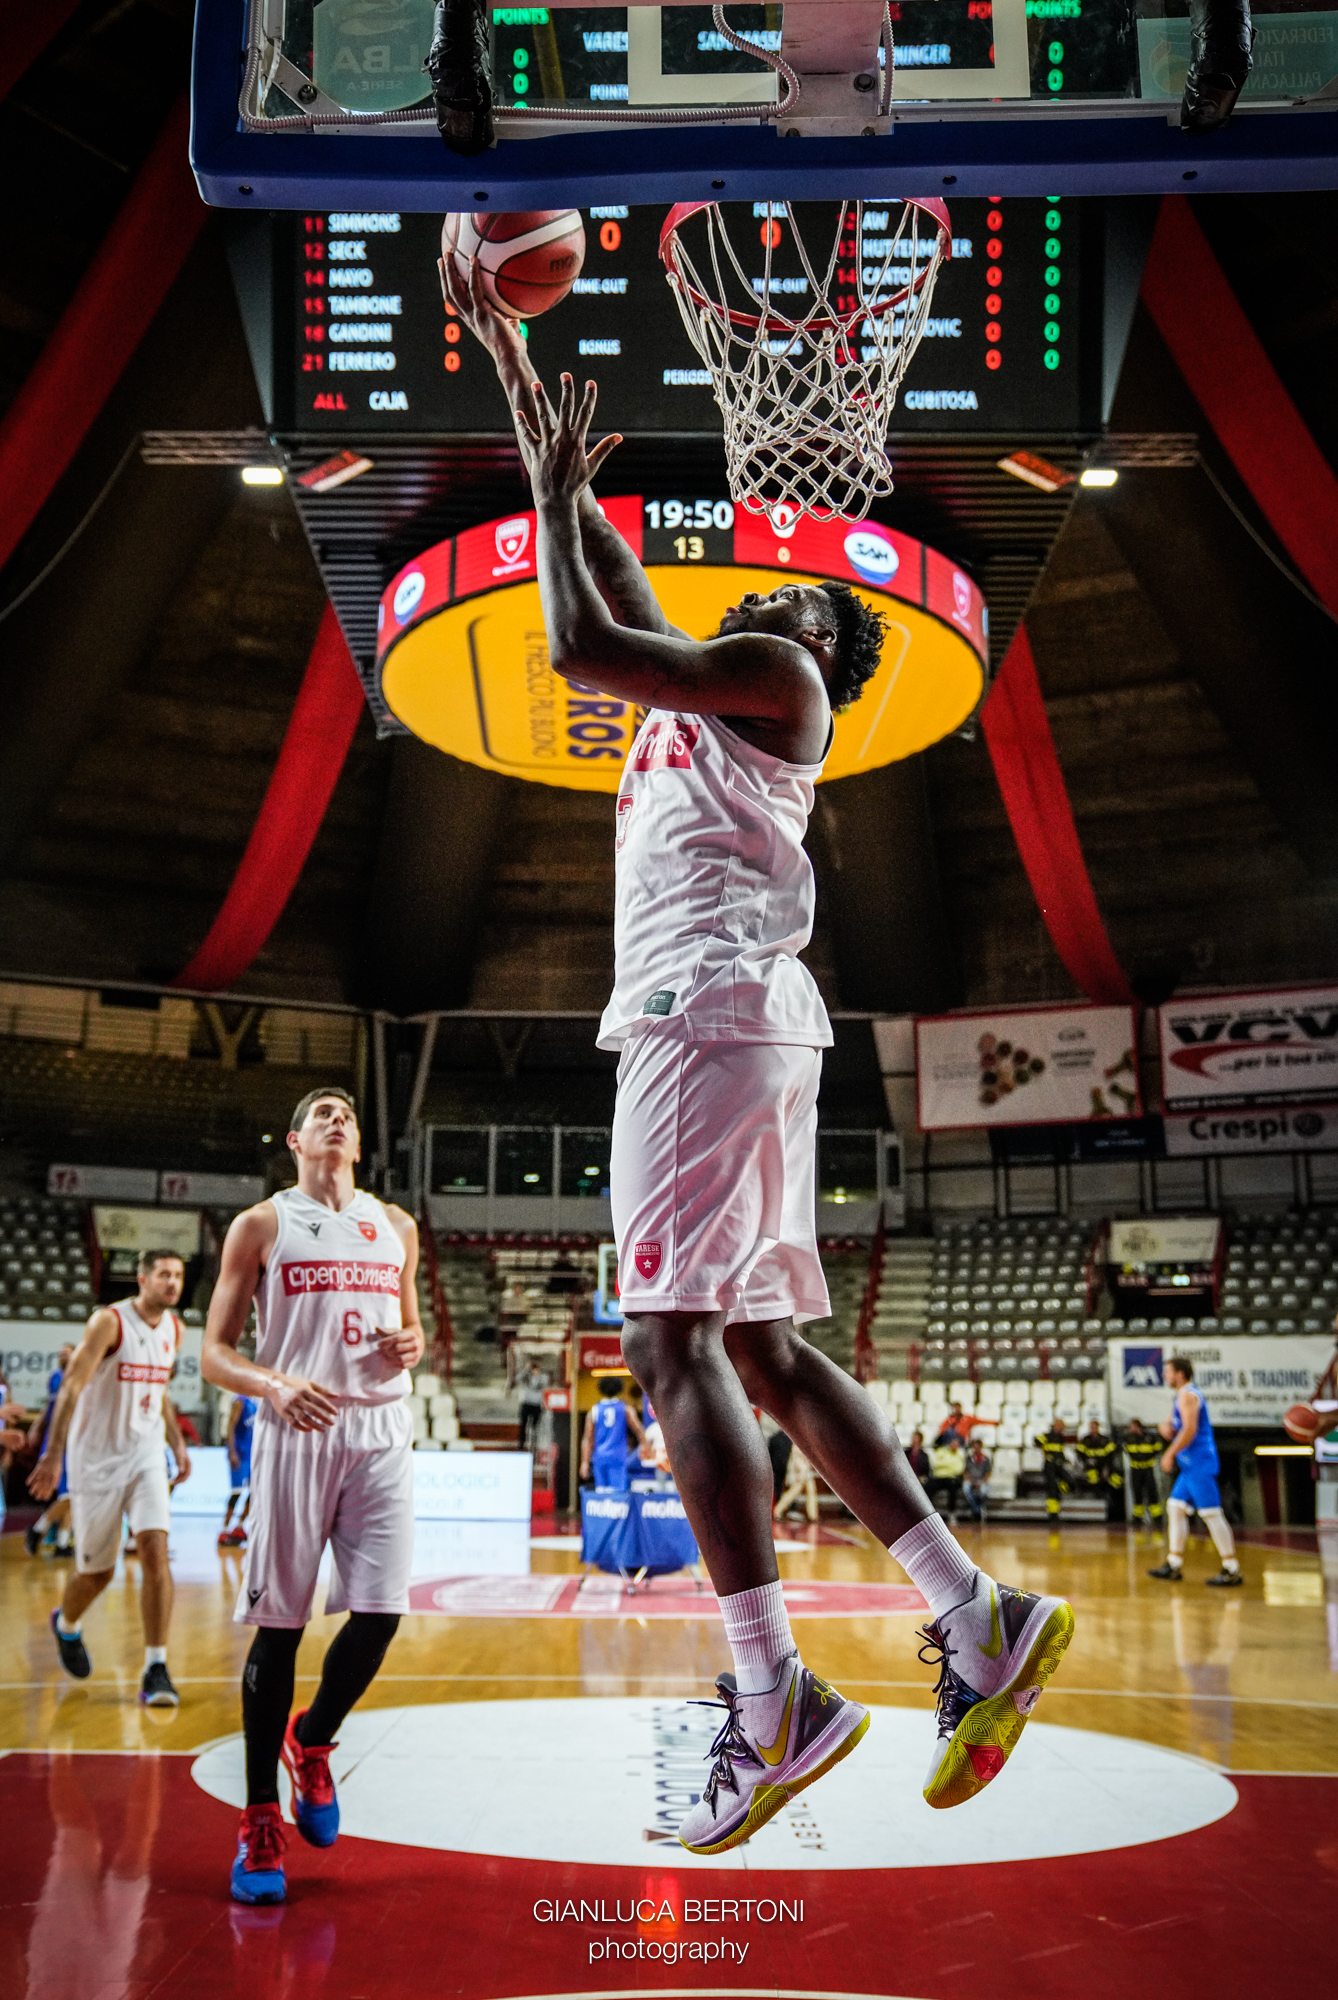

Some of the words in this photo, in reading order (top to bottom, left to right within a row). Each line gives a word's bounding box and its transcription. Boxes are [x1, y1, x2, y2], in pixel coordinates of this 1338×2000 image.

[493, 8, 549, 25] POINTS
[513, 48, 529, 69] 0
[877, 44, 952, 66] NINGER
[1048, 41, 1064, 64] 0
[513, 72, 529, 94] 0
[1048, 68, 1064, 91] 0
[304, 216, 323, 233] 11
[328, 213, 401, 233] SIMMONS
[862, 211, 889, 231] AW
[986, 210, 1003, 231] 0
[1045, 210, 1061, 231] 0
[600, 221, 621, 251] 0
[760, 219, 781, 249] 0
[328, 240, 367, 260] SECK
[986, 238, 1003, 259] 0
[1045, 238, 1061, 259] 0
[304, 270, 324, 287] 14
[328, 268, 374, 288] MAYO
[986, 266, 1002, 287] 0
[1044, 266, 1061, 287] 0
[328, 295, 402, 315] TAMBONE
[985, 293, 1002, 315] 0
[1044, 293, 1060, 315] 0
[328, 323, 393, 342] GANDINI
[444, 322, 461, 343] 0
[985, 321, 1002, 342] 0
[1044, 321, 1060, 342] 0
[578, 339, 621, 355] BONUS
[302, 353, 323, 371] 21
[328, 351, 397, 371] FERRERO
[444, 351, 461, 372] 0
[985, 349, 1002, 370] 0
[1043, 349, 1060, 370] 0
[313, 393, 347, 410] ALL
[369, 391, 409, 410] CAJA
[904, 390, 978, 410] CUBITOSA
[645, 499, 734, 530] 19:50
[771, 504, 796, 538] 0
[673, 536, 705, 560] 13
[777, 546, 791, 563] 0
[1189, 1110, 1288, 1145] Crespi
[635, 1244, 660, 1253] VARESE
[288, 1262, 400, 1291] Openjobmetis
[343, 1308, 363, 1347] 6
[1124, 1366, 1161, 1386] AXA
[1251, 1369, 1309, 1387] TRADING
[140, 1395, 151, 1413] 4
[414, 1471, 501, 1490] OLOGICI
[586, 1498, 630, 1519] molten
